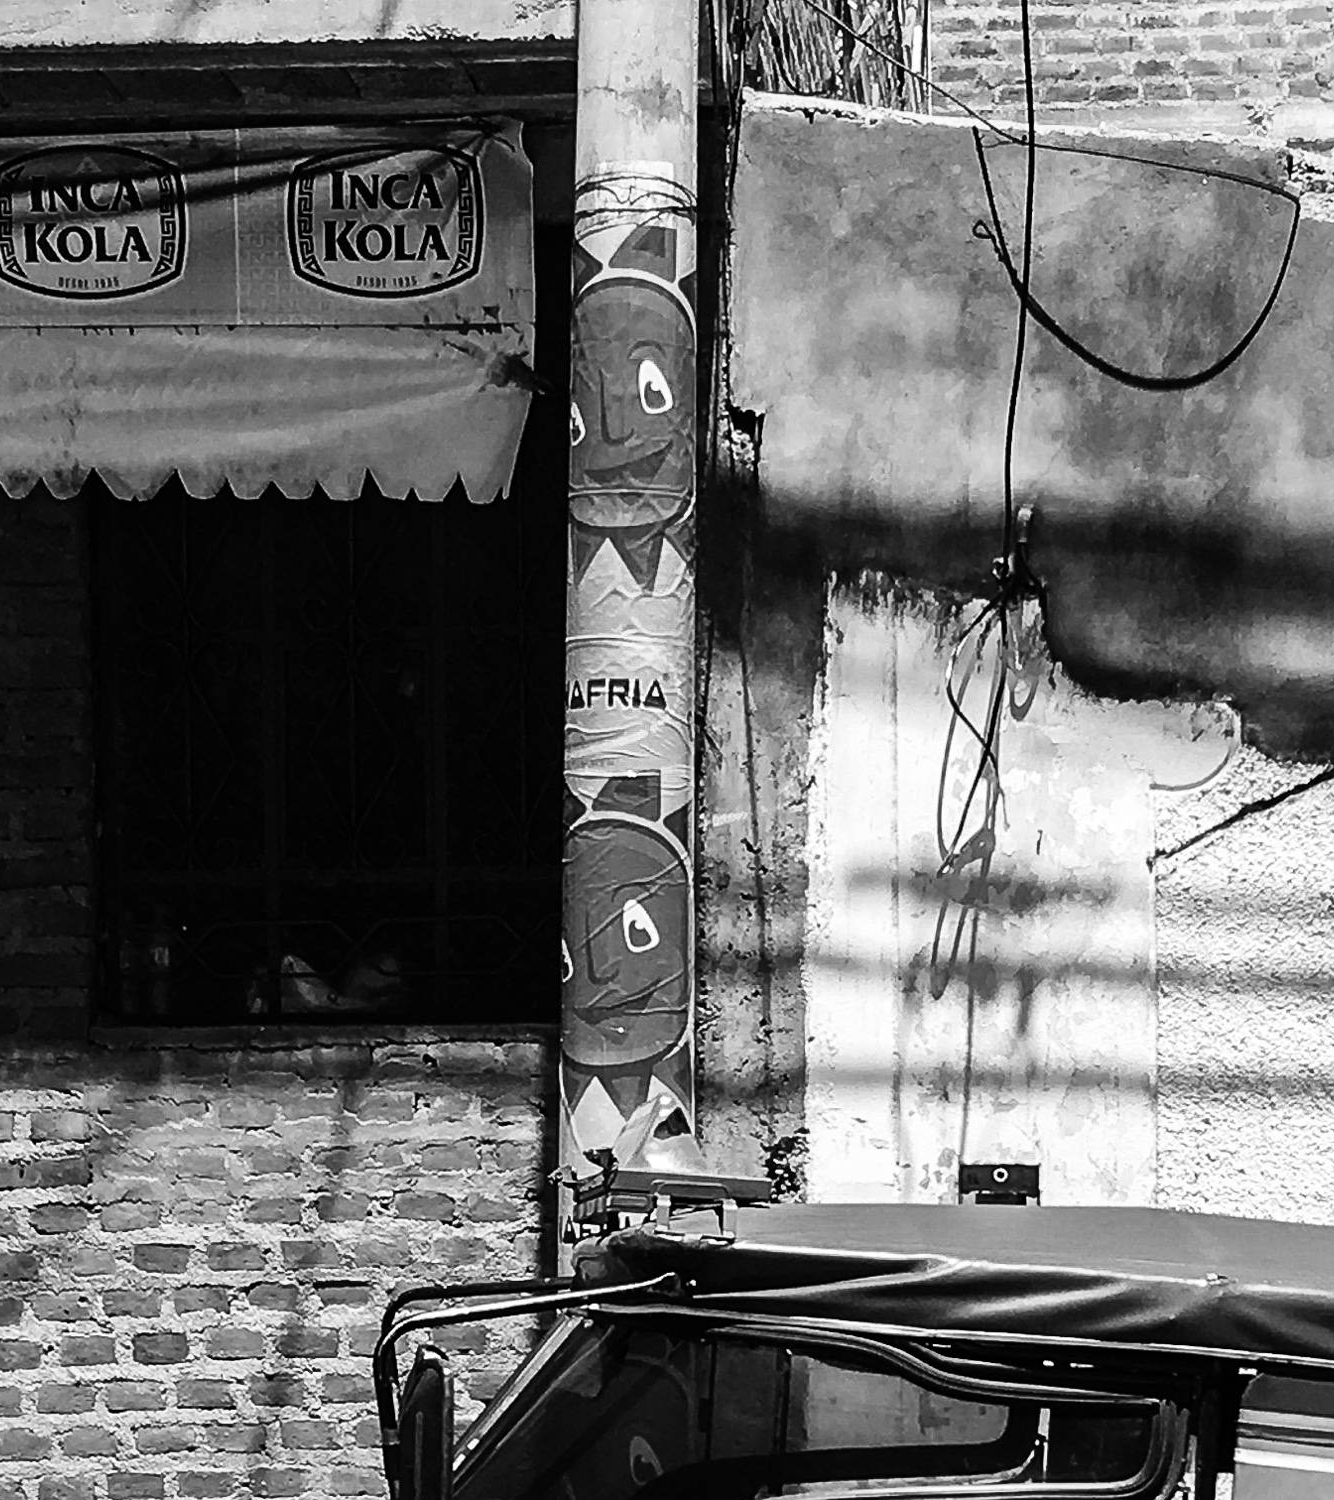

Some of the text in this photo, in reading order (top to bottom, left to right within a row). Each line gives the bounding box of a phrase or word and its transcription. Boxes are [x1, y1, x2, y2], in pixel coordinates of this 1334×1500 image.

[29, 174, 141, 214] INCA
[331, 169, 443, 211] INCA
[24, 221, 153, 266] KOLA
[323, 219, 449, 263] KOLA
[567, 678, 667, 709] AFRIA
